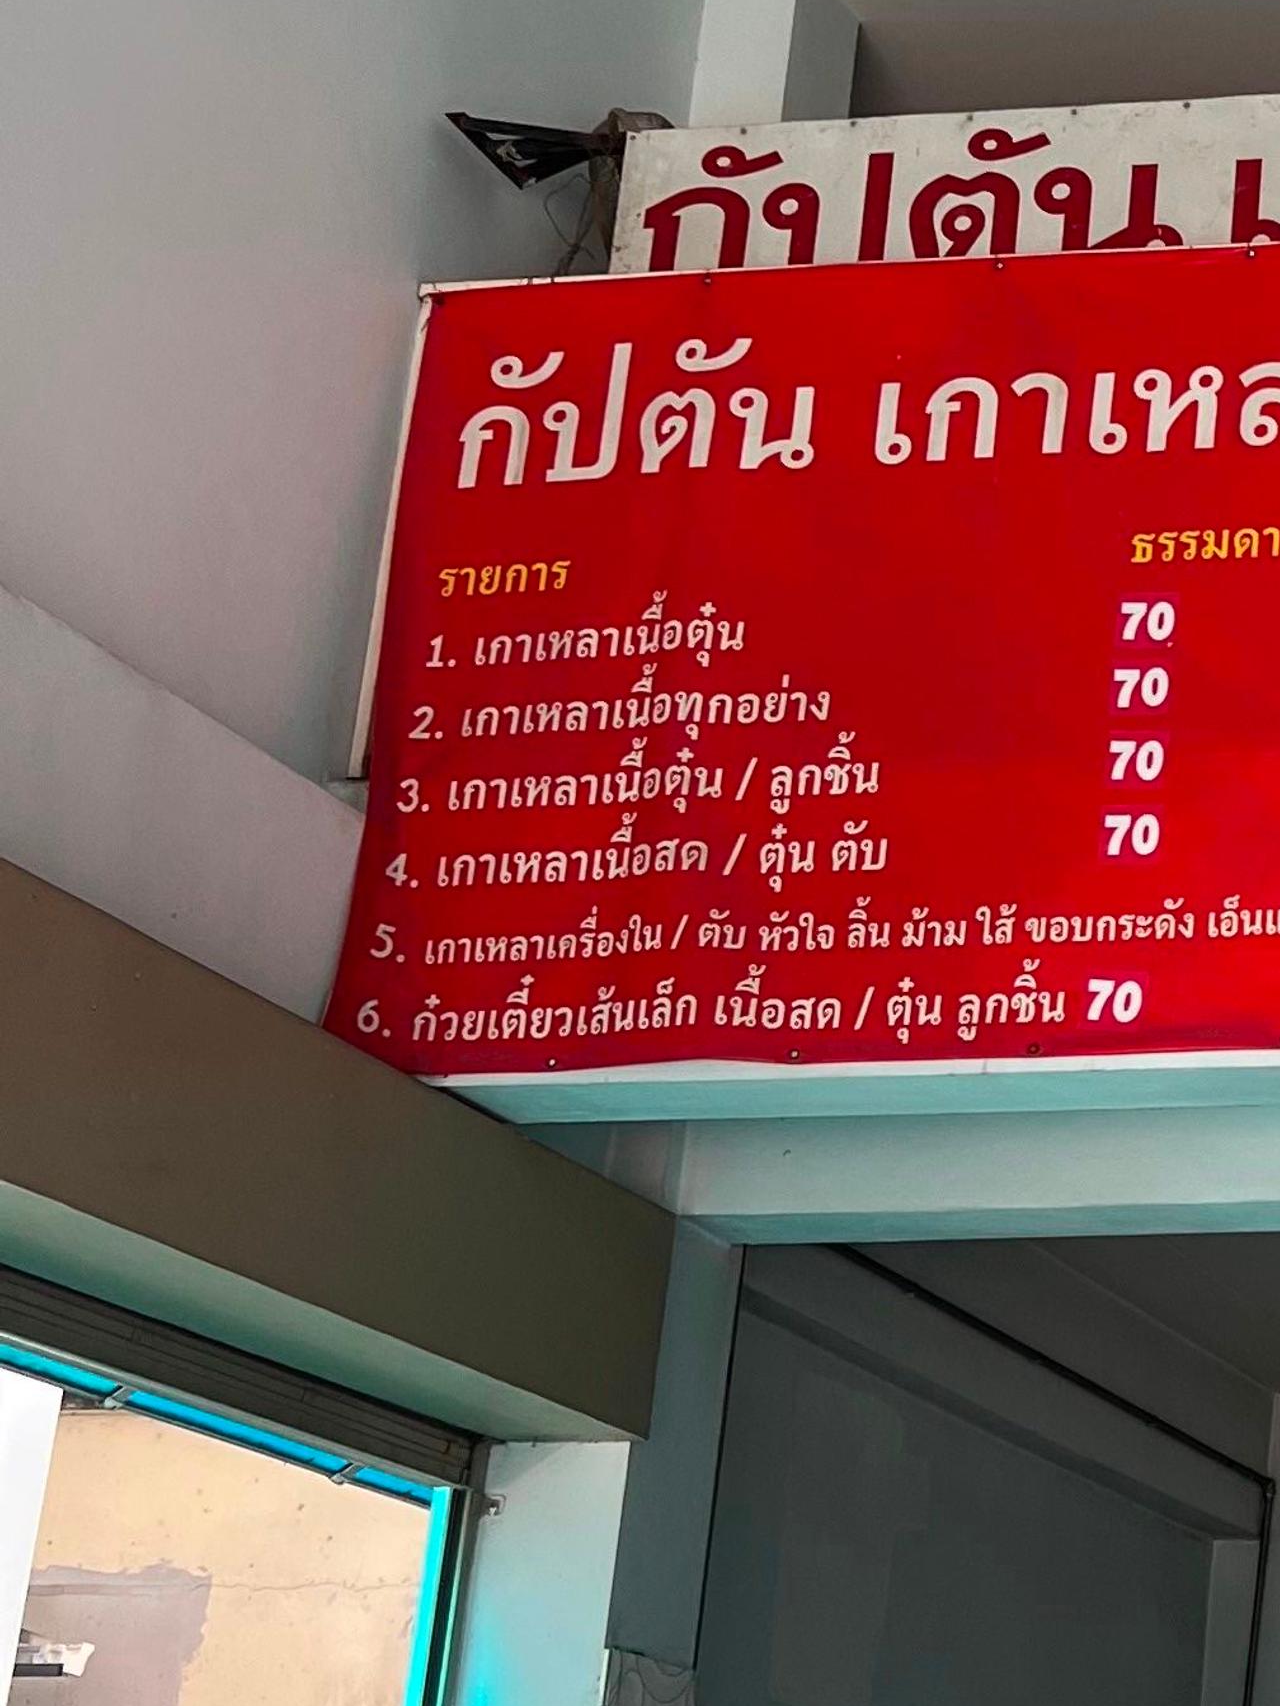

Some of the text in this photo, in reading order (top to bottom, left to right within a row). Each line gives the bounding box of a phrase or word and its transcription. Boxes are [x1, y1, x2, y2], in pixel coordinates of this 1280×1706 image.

[643, 128, 1188, 273] กัปตัน
[458, 337, 815, 489] กัปตัน
[439, 561, 570, 597] รายการ
[1131, 527, 1280, 563] ธรรมดา
[425, 635, 456, 668] 1.
[475, 590, 745, 667] เกาเหลาเนื้อตุ๋น
[1121, 601, 1175, 641] 70
[409, 706, 443, 739] 2.
[462, 663, 831, 740] เกาเหลาเนื้อทุกอย่าง
[1113, 667, 1169, 708] 70
[396, 778, 429, 813] 3.
[448, 737, 723, 814] เกาเหลาเนื้อตุ๋น
[770, 731, 879, 815] ลูกชิ้น
[1109, 740, 1164, 781] 70
[386, 853, 418, 888] 4.
[437, 812, 708, 887] เกาเหลาเนื้อสด
[759, 823, 815, 893] ตุ๋น
[831, 820, 888, 872] ตับ
[1104, 813, 1160, 856] 70
[371, 924, 404, 963] 5.
[425, 905, 662, 965] เกาเหลาเครื่องใน
[698, 908, 746, 949] ตับ
[758, 911, 835, 951] หัวใจ
[847, 896, 890, 948] ลิ้น
[901, 907, 967, 947] ม้าม
[358, 1000, 390, 1036] 6.
[413, 974, 697, 1041] ก๋วยเตี๋ยวเส้นเล็ก
[714, 963, 841, 1030] เนื้อสด
[886, 976, 942, 1045] ตุ๋น
[957, 958, 1065, 1041] ลูกชิ้น
[1087, 978, 1143, 1023] 70
